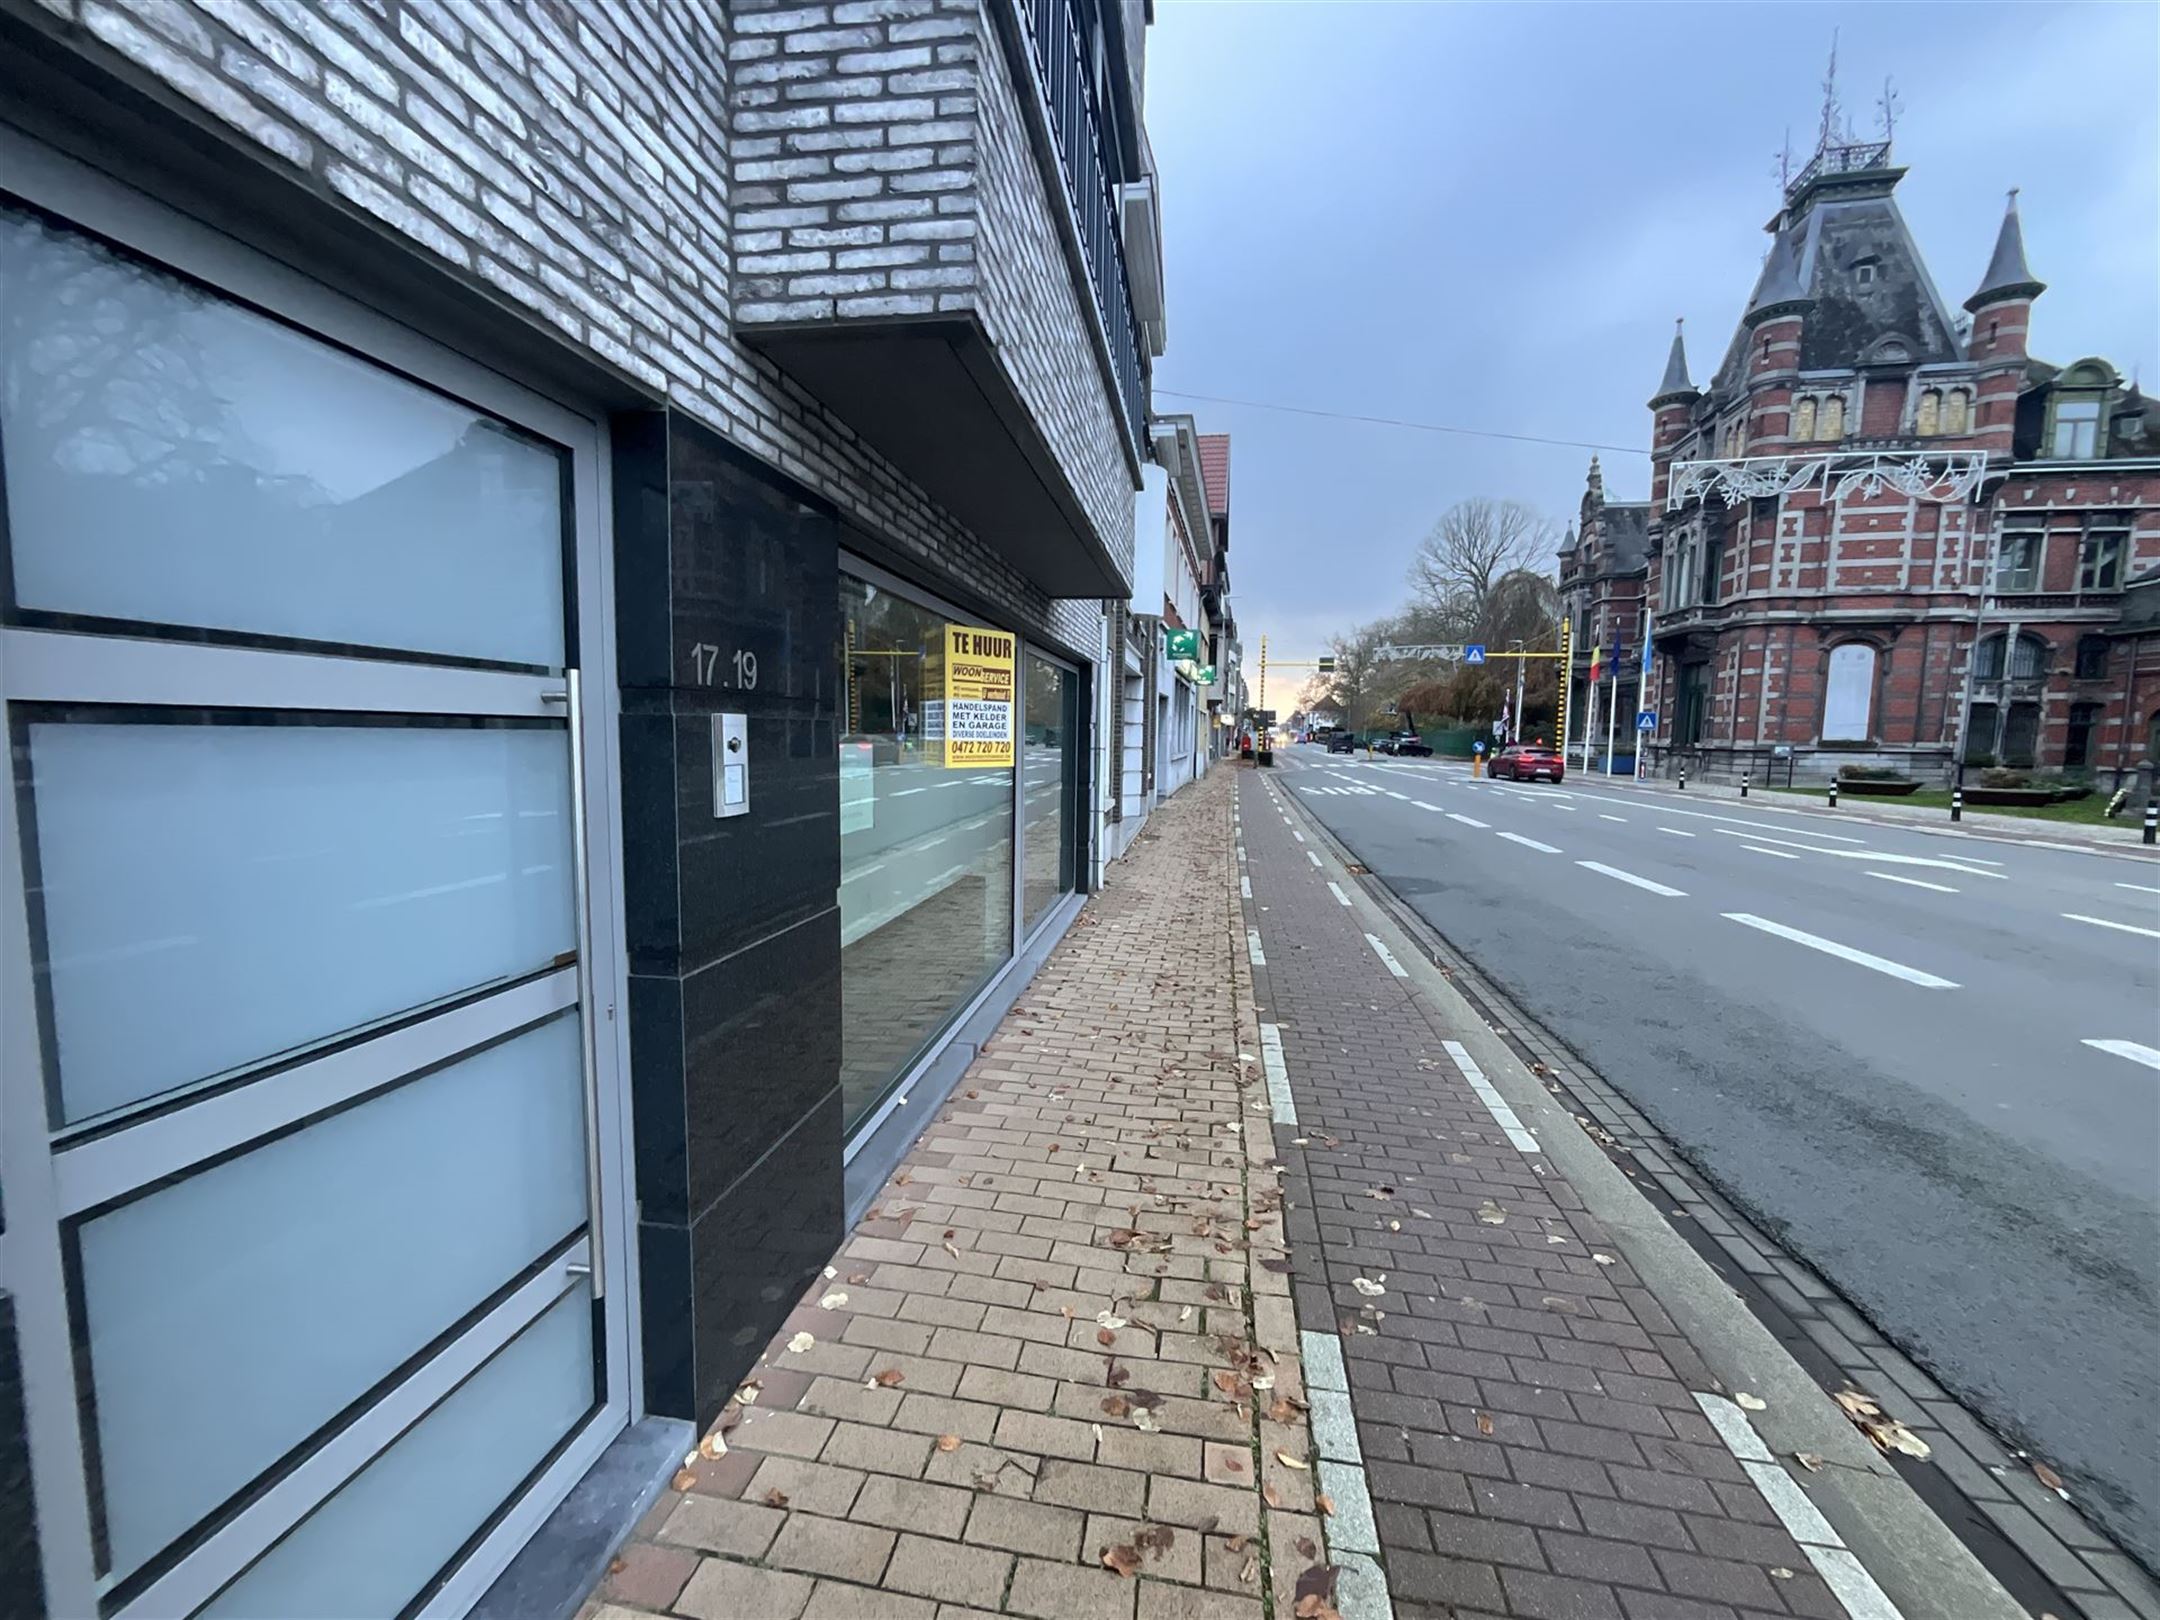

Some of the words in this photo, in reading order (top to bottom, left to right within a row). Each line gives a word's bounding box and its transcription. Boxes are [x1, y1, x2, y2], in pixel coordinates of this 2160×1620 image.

[952, 632, 969, 654] TE
[973, 634, 1012, 658] HUUR
[952, 702, 1008, 712] HANDELSPAND
[952, 712, 971, 720] MET
[974, 712, 1008, 721] KELDER
[952, 721, 966, 729] EN
[968, 721, 1007, 730] GARAGE
[952, 730, 975, 739] DIVERSE
[952, 741, 974, 753] 0472
[976, 741, 993, 753] 720
[995, 741, 1011, 753] 720
